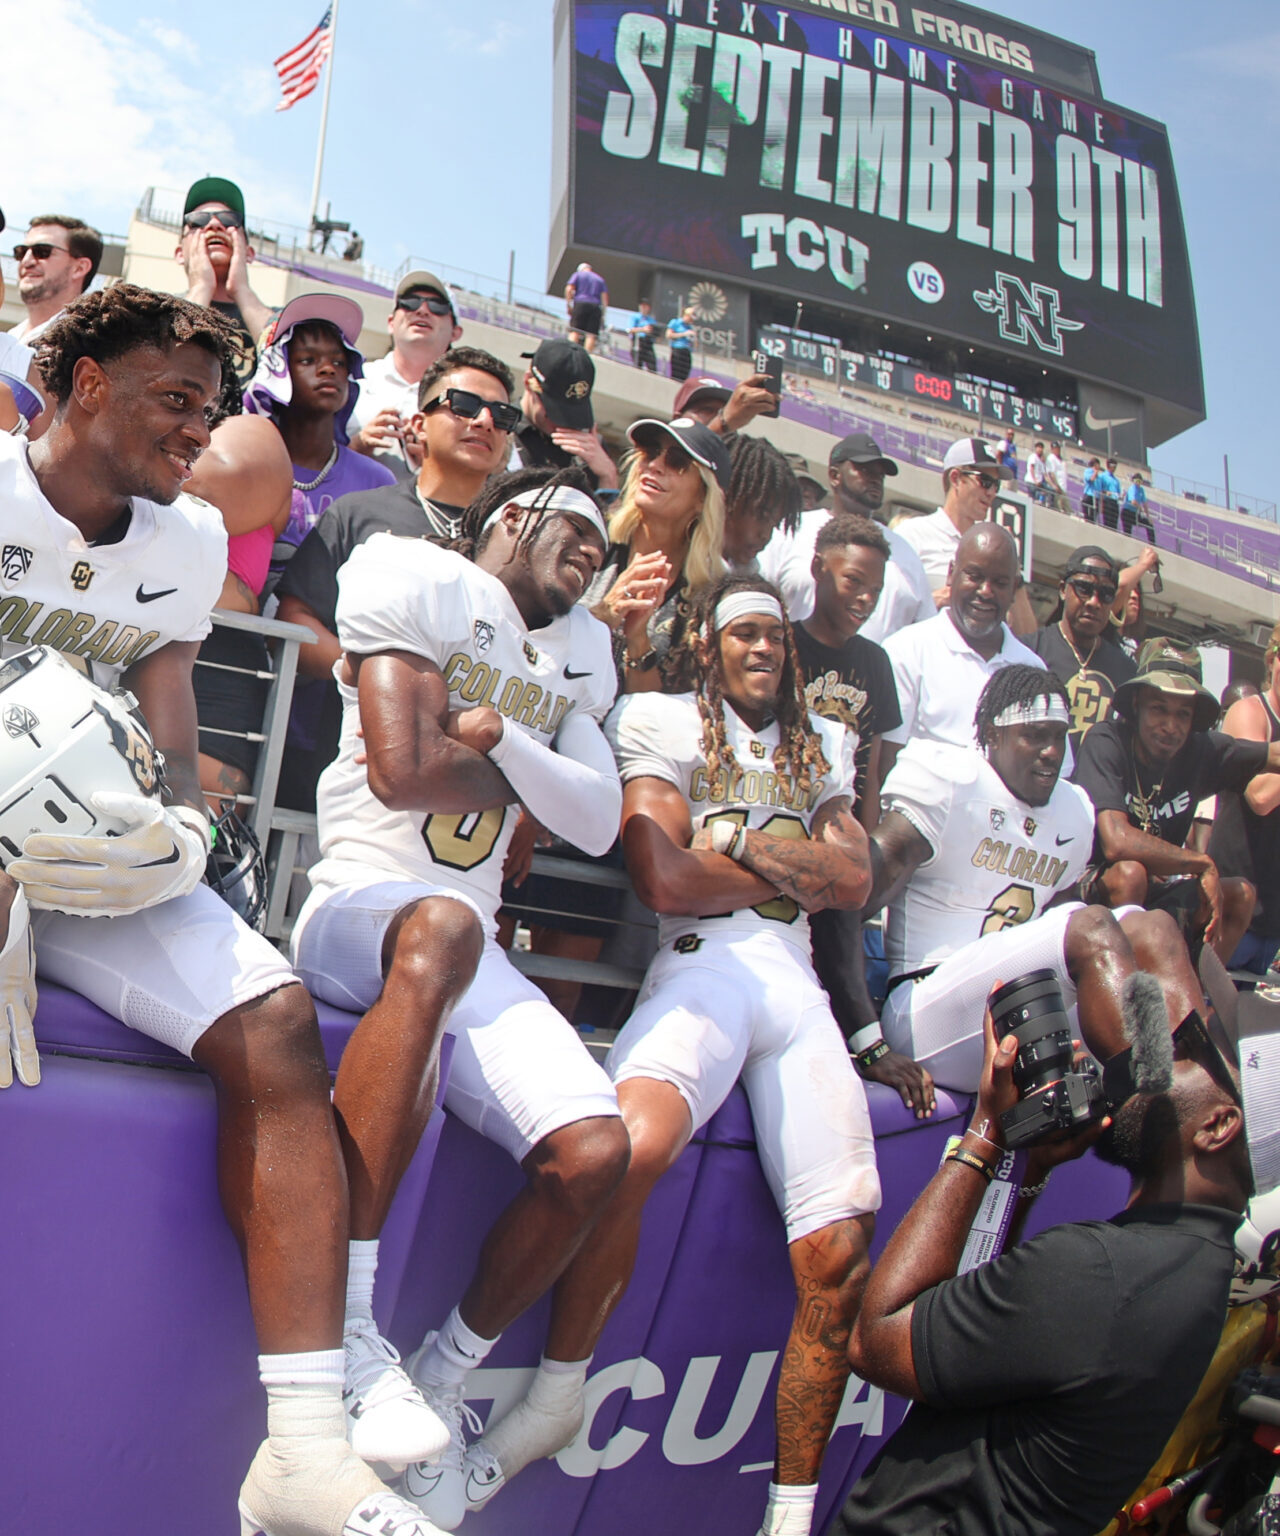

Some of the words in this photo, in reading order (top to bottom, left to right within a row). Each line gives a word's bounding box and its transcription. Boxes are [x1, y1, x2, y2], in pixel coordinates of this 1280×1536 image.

[911, 8, 1035, 74] FROGS
[666, 0, 789, 42] NEXT
[837, 27, 958, 92] HOME
[1000, 78, 1106, 144] GAME
[601, 13, 1035, 262] SEPTEMBER
[1055, 134, 1164, 308] 9TH
[741, 213, 869, 292] TCU
[911, 269, 940, 295] VS
[760, 337, 787, 357] 42
[791, 338, 818, 360] TCU
[823, 356, 835, 376] 0
[846, 362, 858, 382] 2
[877, 371, 891, 390] 10
[914, 373, 952, 401] 0:00
[962, 394, 980, 413] 47
[993, 403, 1003, 419] 4
[1026, 402, 1041, 421] CU
[1013, 408, 1022, 426] 2
[1052, 414, 1074, 437] 45
[1, 545, 34, 574] PAC
[3, 563, 23, 581] 12
[70, 561, 95, 591] CU
[443, 652, 576, 735] COLORAD
[998, 1150, 1016, 1180] TCU
[986, 1189, 1000, 1224] COLORADO
